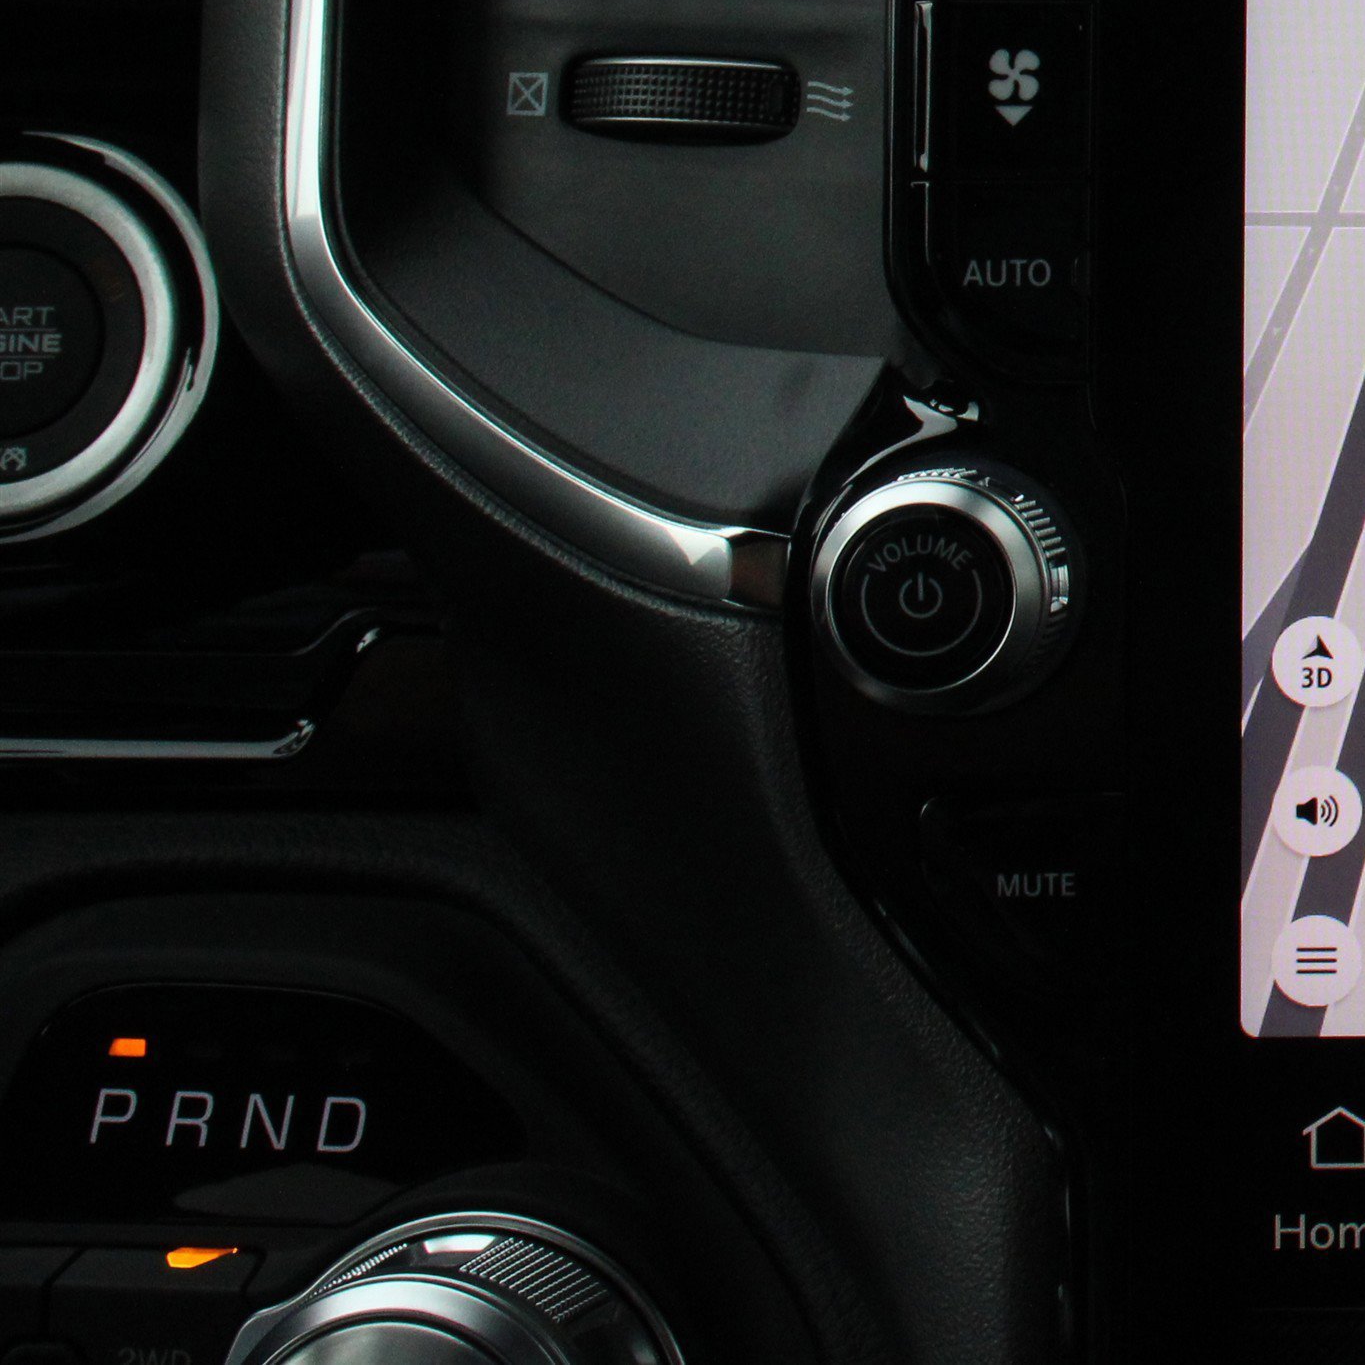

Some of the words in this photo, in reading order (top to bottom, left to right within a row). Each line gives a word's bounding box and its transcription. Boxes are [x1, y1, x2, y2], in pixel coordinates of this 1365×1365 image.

[963, 258, 1052, 287] AUTO
[0, 361, 44, 381] OP
[866, 533, 975, 575] VOLUME
[1301, 667, 1333, 689] 3D
[997, 872, 1075, 897] MUTE
